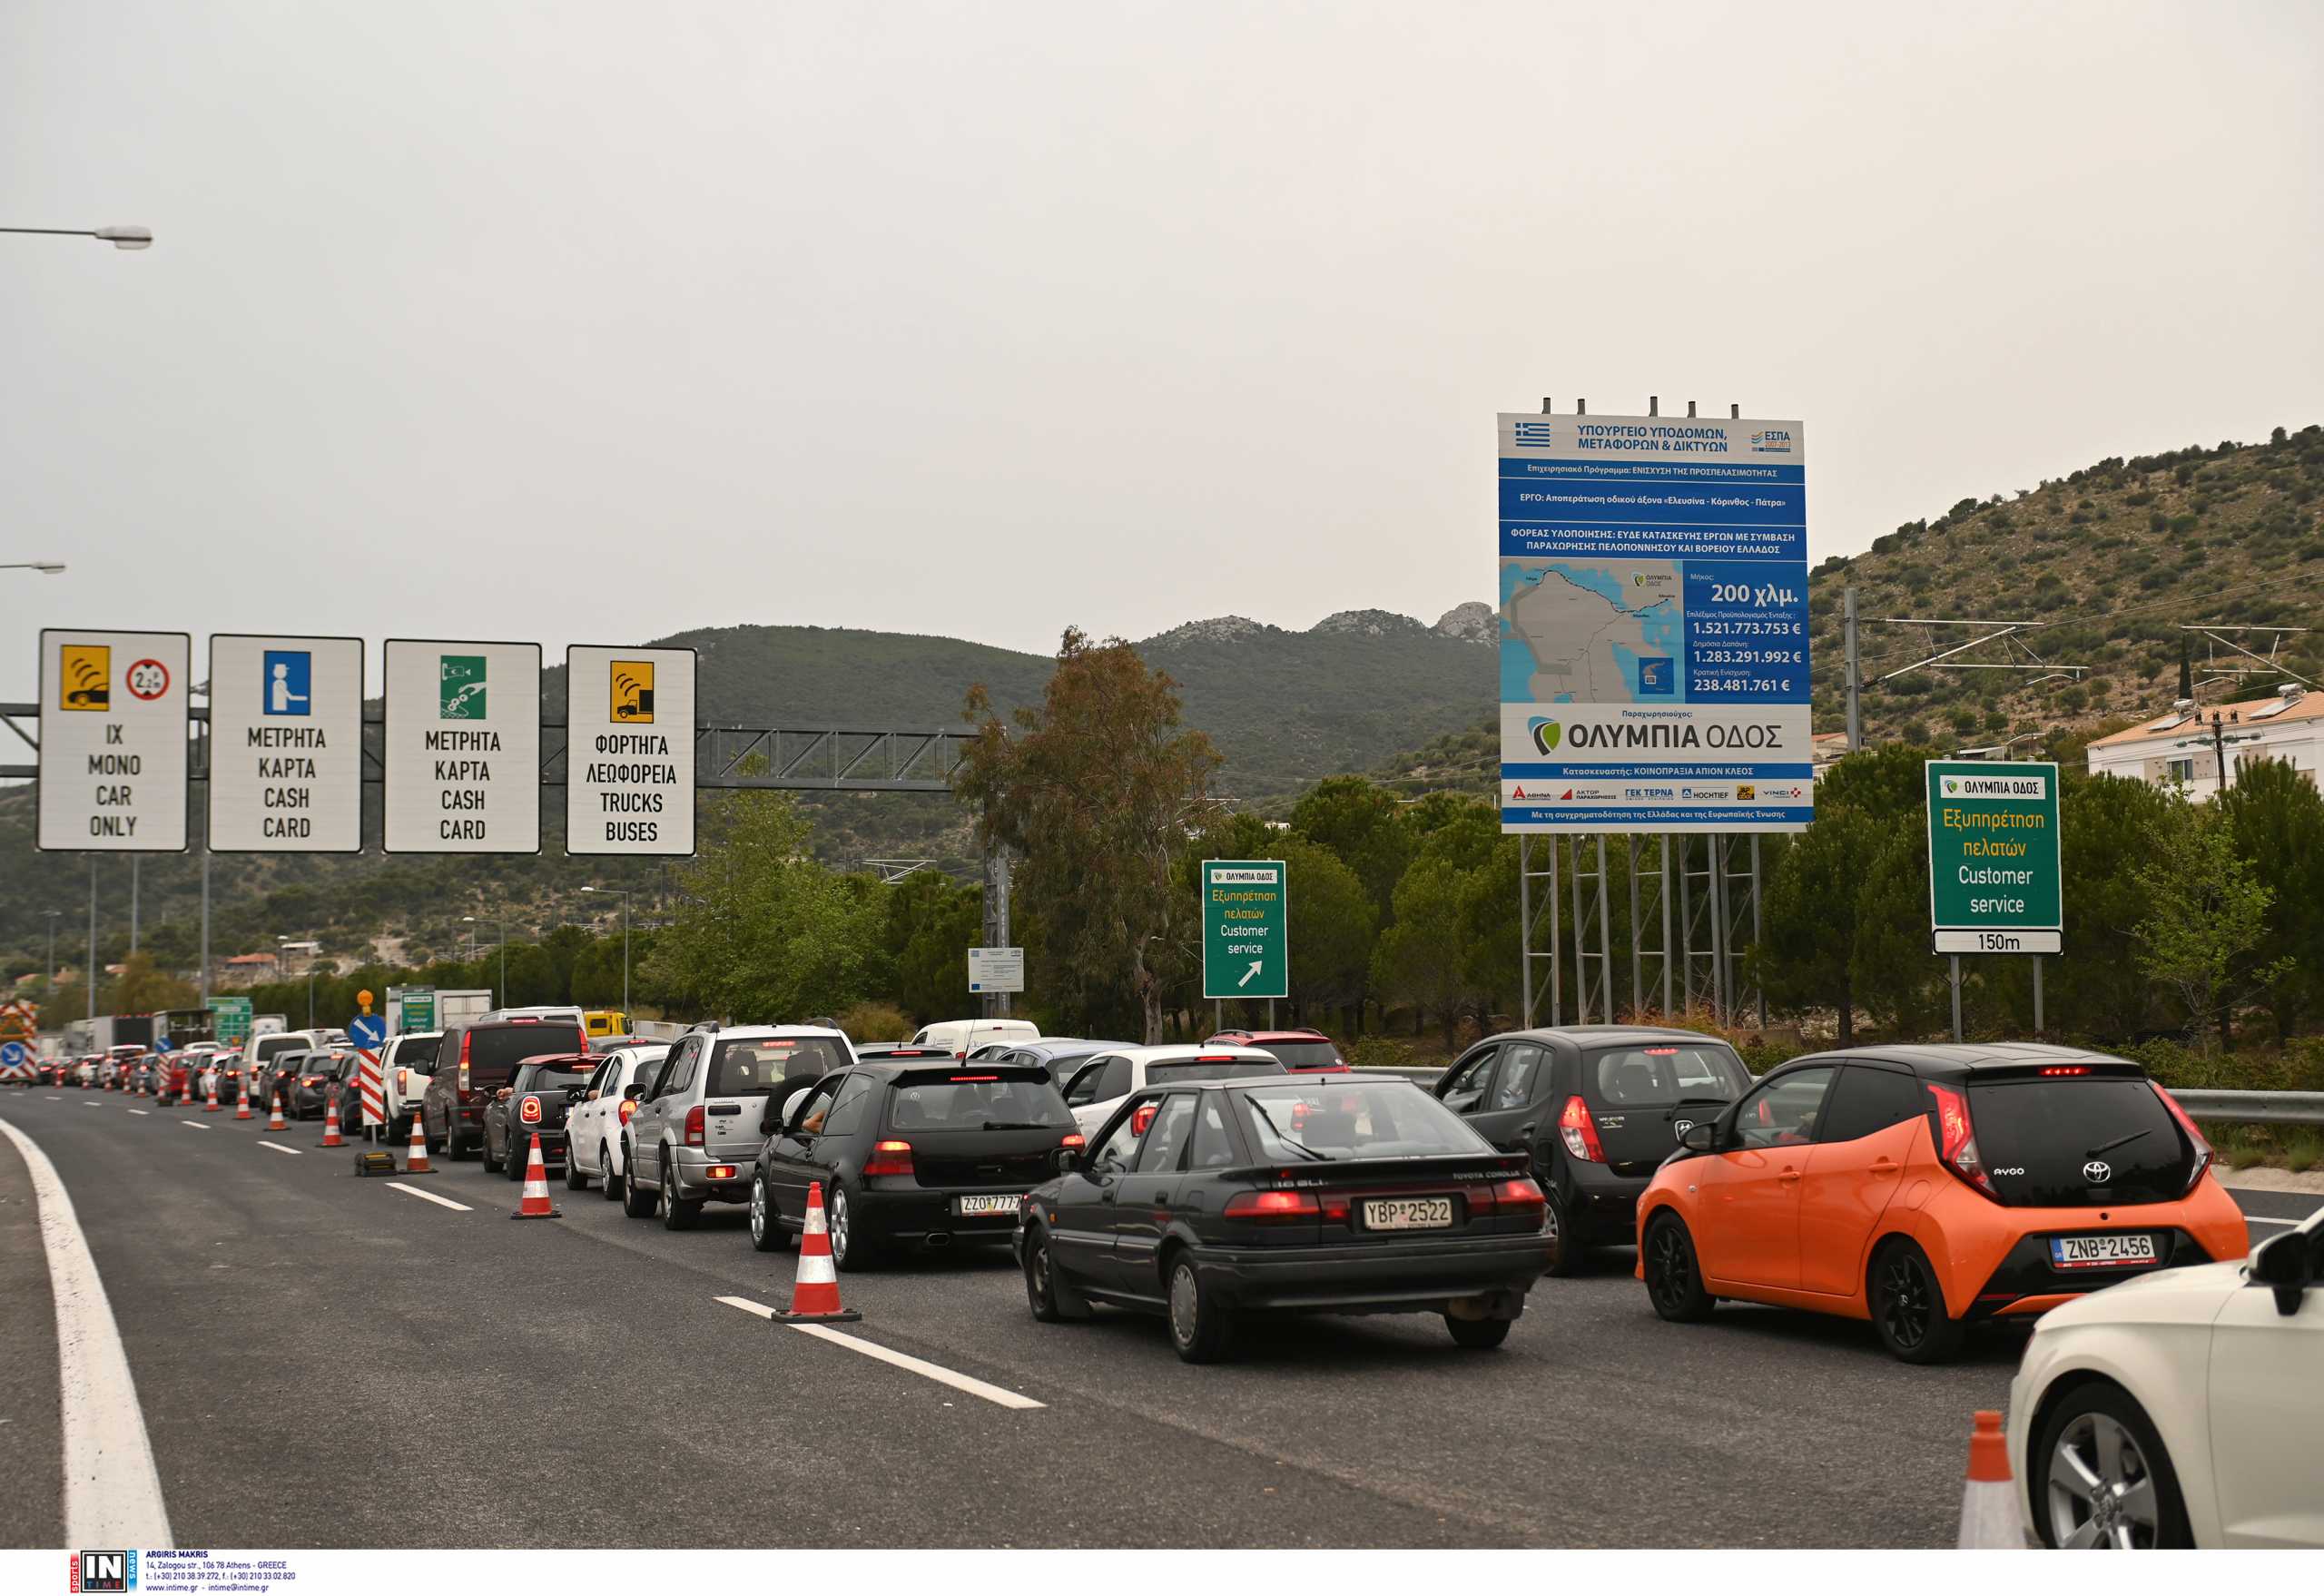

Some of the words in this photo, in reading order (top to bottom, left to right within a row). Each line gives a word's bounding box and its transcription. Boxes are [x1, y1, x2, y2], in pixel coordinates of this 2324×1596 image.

[1577, 425, 1647, 438] ΥΠΟΥΡΓΕΙΟ
[1649, 427, 1728, 440] ΥΠΟΔΟΜΩΝ,
[1765, 431, 1790, 441] ΕΣΠΑ
[1578, 438, 1659, 451] ΜΕΤΑΦΟΡΩΝ
[1662, 441, 1671, 451] &
[1672, 441, 1728, 452] ΔΙΚΤΥΩΝ
[1527, 464, 1583, 474] Επιχειρησιακό
[1584, 466, 1631, 475] Πρόγραμμα:
[1632, 467, 1671, 475] ΕΝΙΣΧΥΣΗ
[1689, 468, 1777, 478] ΠΡΟΣΠΕΛΑΣΙΜΟΤΗΤΑΣ
[1520, 493, 1544, 502] ΕΡΓΟ:
[1546, 494, 1605, 505] Αποπεράτωση
[1607, 495, 1635, 504] οδικού
[1637, 496, 1662, 505] άξονα
[1664, 497, 1705, 505] «Ελευσίνα
[1711, 498, 1749, 507] Κόρινθος
[1511, 528, 1550, 537] ΦΟΡΕΑΣ
[1551, 529, 1616, 538] ΥΛΟΠΟΙΗΣΗΣ:
[1617, 530, 1640, 539] ΕΥΔΕ
[1642, 531, 1702, 540] ΚΑΤΑΣΚΕΥΗΣ
[1703, 532, 1734, 541] ΕΡΓΩΝ
[1735, 533, 1750, 541] ΜΕ
[1750, 534, 1795, 542] ΣΥΜΒΑΣΗ
[1526, 541, 1597, 551] ΠΑΡΑΧΩΡΗΣΗΣ
[1599, 543, 1678, 552] ΠΕΛΟΠΟΝΝΗΣΟΥ
[1679, 545, 1693, 553] ΚΑΙ
[1696, 545, 1736, 553] ΒΟΡΕΙΟΥ
[1738, 546, 1780, 554] ΕΛΛΑΔΟΣ
[1711, 584, 1750, 602] 200
[1754, 583, 1799, 607] χλμ.
[1693, 622, 1789, 635] 1.521.773.753
[1792, 623, 1801, 635] €
[1694, 651, 1790, 663] 1.283.291.992
[1793, 651, 1802, 663] €
[1694, 679, 1777, 691] 238.481.761
[1781, 679, 1790, 691] €
[1621, 710, 1693, 719] Παραχωρησιούχος:
[106, 724, 123, 744] ΙΧ
[248, 727, 326, 748] ΜΕΤΡΗΤΑ
[426, 731, 500, 751] ΜΕΤΡΗΤΑ
[1568, 724, 1700, 749] ΟΛΥΜΠΙΑ
[1706, 724, 1783, 749] ΟΔΟΣ
[596, 734, 668, 754] ΦΟΡΤΗΓΑ
[89, 754, 141, 775] ΜΟΝΟ
[260, 758, 316, 778] ΚΑΡΤΑ
[436, 761, 490, 781] ΚΑΡΤΑ
[1562, 768, 1632, 776] Κατασκευαστής:
[1634, 767, 1694, 775] ΚΟΙΝΟΠΡΑΞΙΑ
[586, 764, 676, 783] ΛΕΩΦΟΡΕΙΑ
[96, 785, 131, 805] CAR
[1625, 788, 1641, 796] ΓΕΚ
[1644, 788, 1674, 796] ΤΕΡΝΑ
[1965, 781, 2010, 793] ΟΛΥΜΠΙΑ
[2013, 783, 2039, 794] ΟΔΟΣ
[265, 788, 309, 808] CASH
[442, 790, 484, 810] CASH
[600, 793, 662, 813] TRUCKS
[1555, 811, 1631, 820] συγχρηματοδότηση
[1648, 811, 1679, 819] Ελλάδας
[1708, 811, 1755, 819] Ευρωπαϊκής
[1943, 808, 2044, 832] Εξυπηρέτηση
[90, 816, 136, 836] ONLY
[264, 818, 310, 837] CARD
[440, 820, 485, 839] CARD
[606, 822, 657, 842] BUSES
[1963, 838, 2027, 857] πελατών
[1226, 872, 1255, 881] ΟΛΥΜΠΙΑ
[1256, 872, 1273, 881] ΟΔΟΣ
[1958, 865, 2034, 885] Customer
[1212, 890, 1276, 905] Εξυπηρέτηση
[1970, 895, 2024, 913] service
[1225, 908, 1265, 920] πελατών
[1220, 925, 1268, 937] Customer
[1227, 941, 1264, 954] service
[1978, 934, 2020, 951] 150m
[1452, 1172, 1484, 1180] TOYOTA
[1994, 1167, 2024, 1176] AYGO
